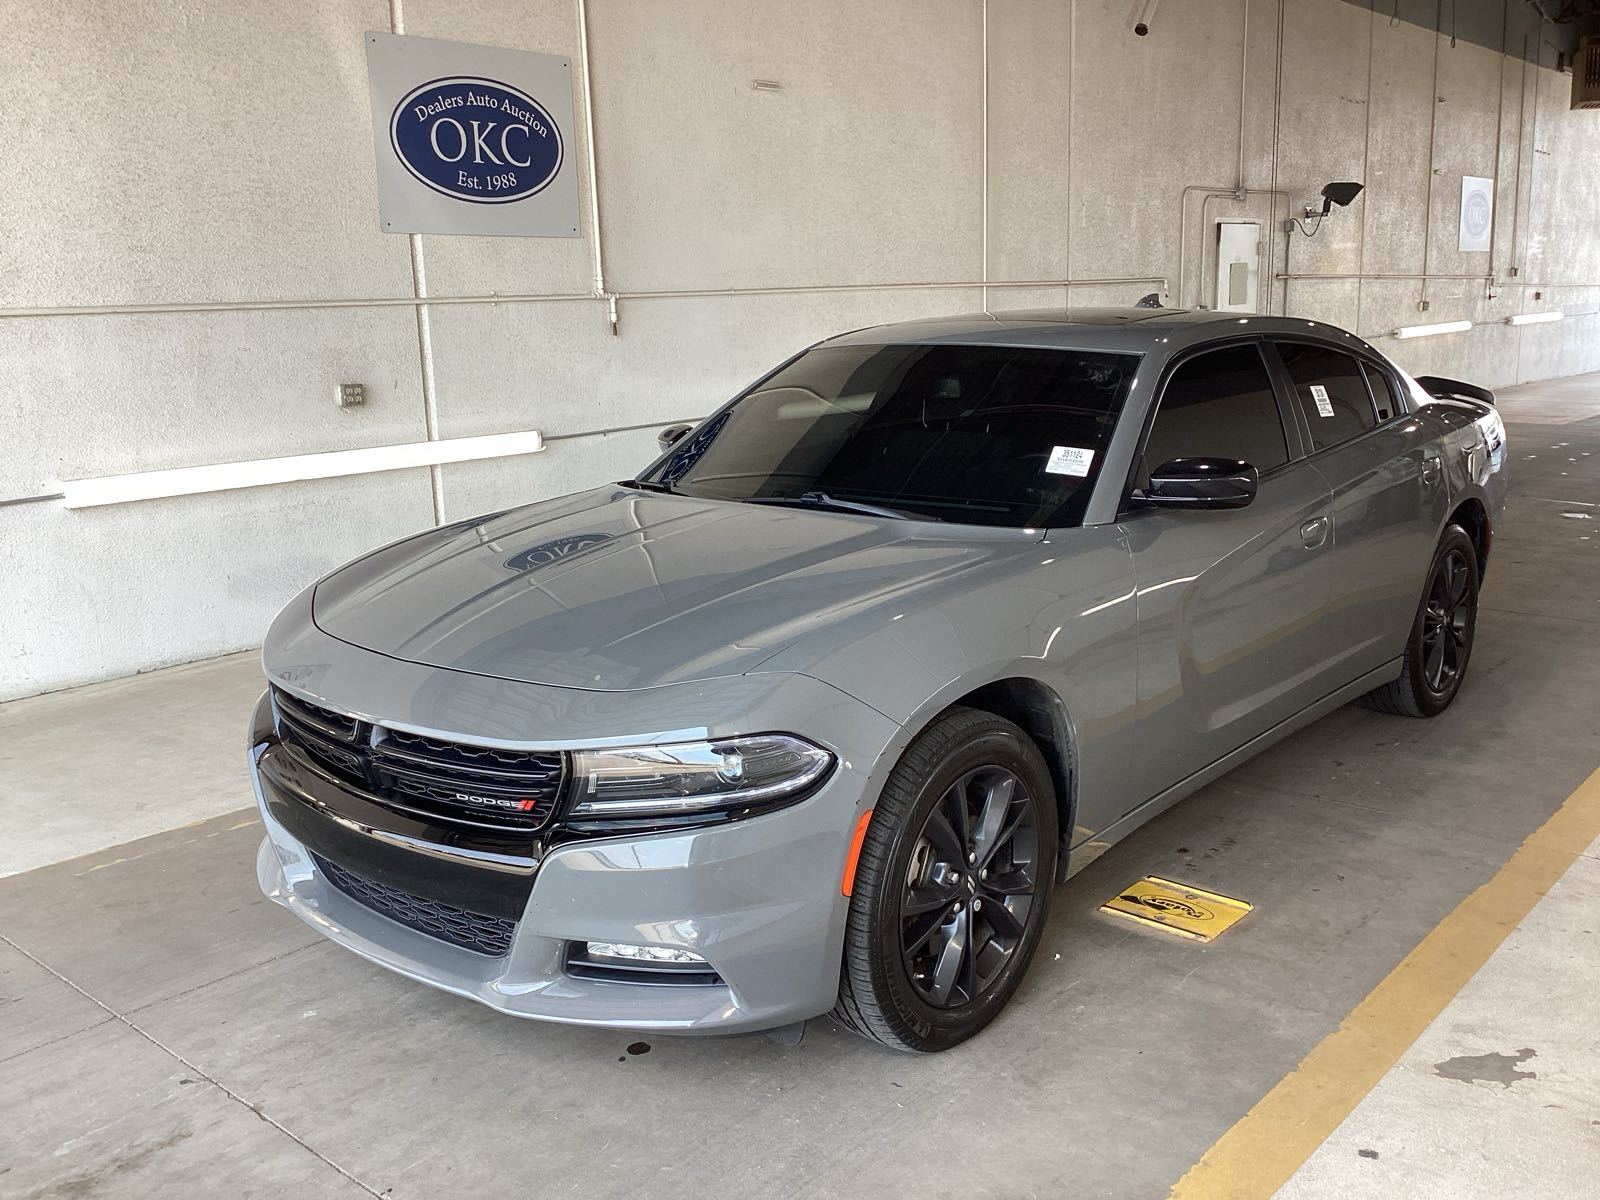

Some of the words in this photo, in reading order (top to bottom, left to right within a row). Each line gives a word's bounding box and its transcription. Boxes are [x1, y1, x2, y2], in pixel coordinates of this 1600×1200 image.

[413, 94, 464, 122] Dealers
[466, 91, 498, 109] Auto
[500, 99, 549, 139] Auction
[430, 117, 531, 168] OKC
[457, 170, 482, 190] Est.
[486, 172, 517, 190] 1988
[456, 793, 523, 808] DODGE
